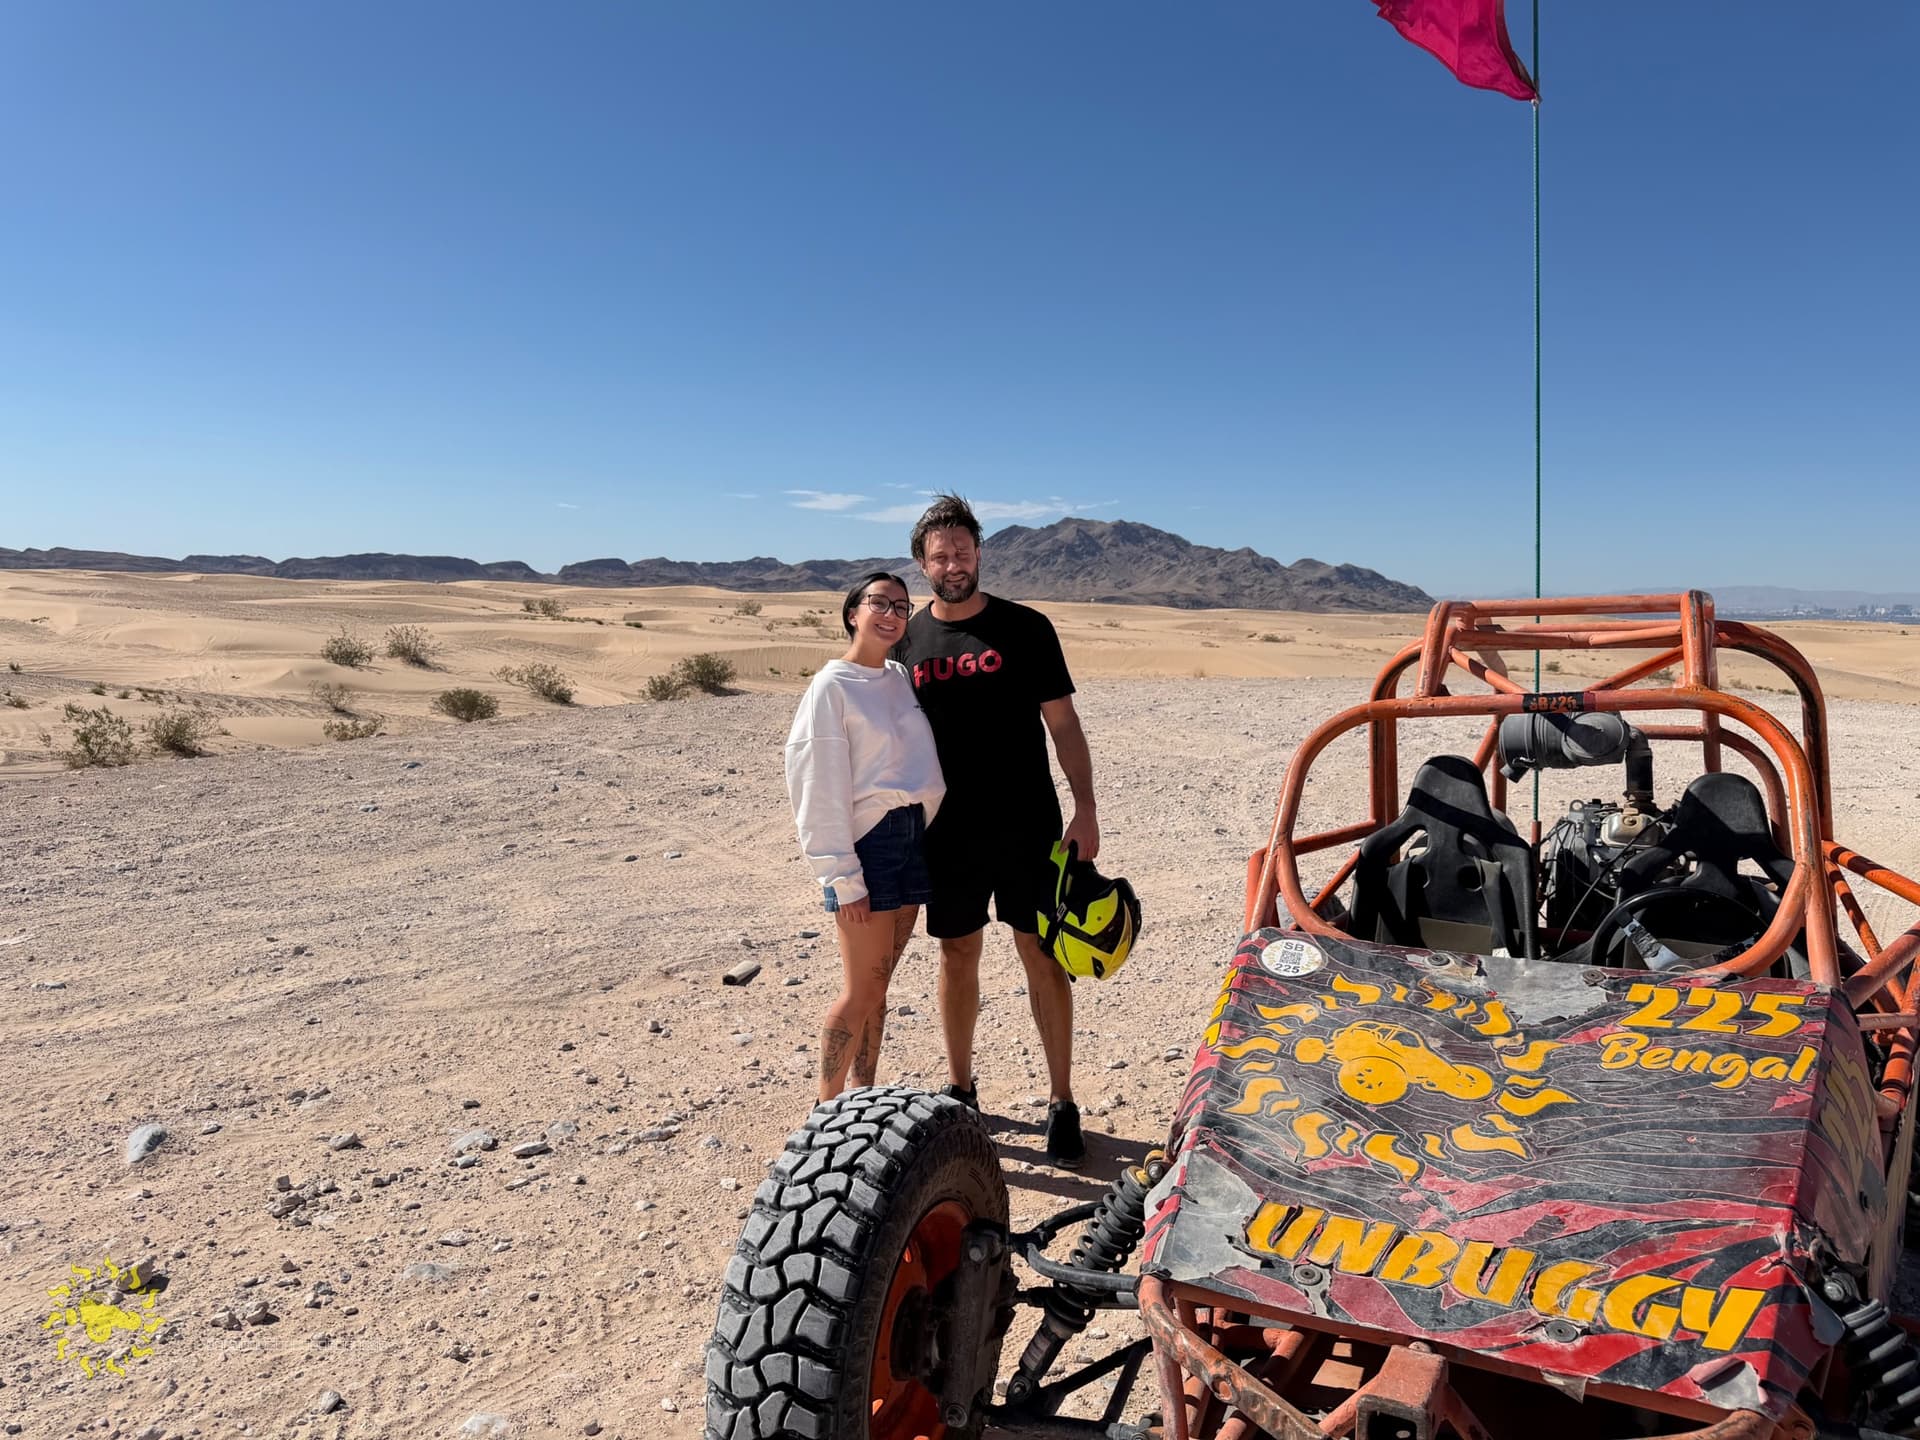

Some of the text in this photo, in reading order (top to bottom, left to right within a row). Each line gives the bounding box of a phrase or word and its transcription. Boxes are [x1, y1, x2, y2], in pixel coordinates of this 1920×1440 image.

[913, 649, 1002, 688] HUGO
[1274, 962, 1301, 974] 225
[1284, 941, 1305, 952] SB
[1618, 983, 1807, 1037] 225
[1600, 1031, 1818, 1090] Bengal
[1246, 1201, 1767, 1352] UNBUGGY
